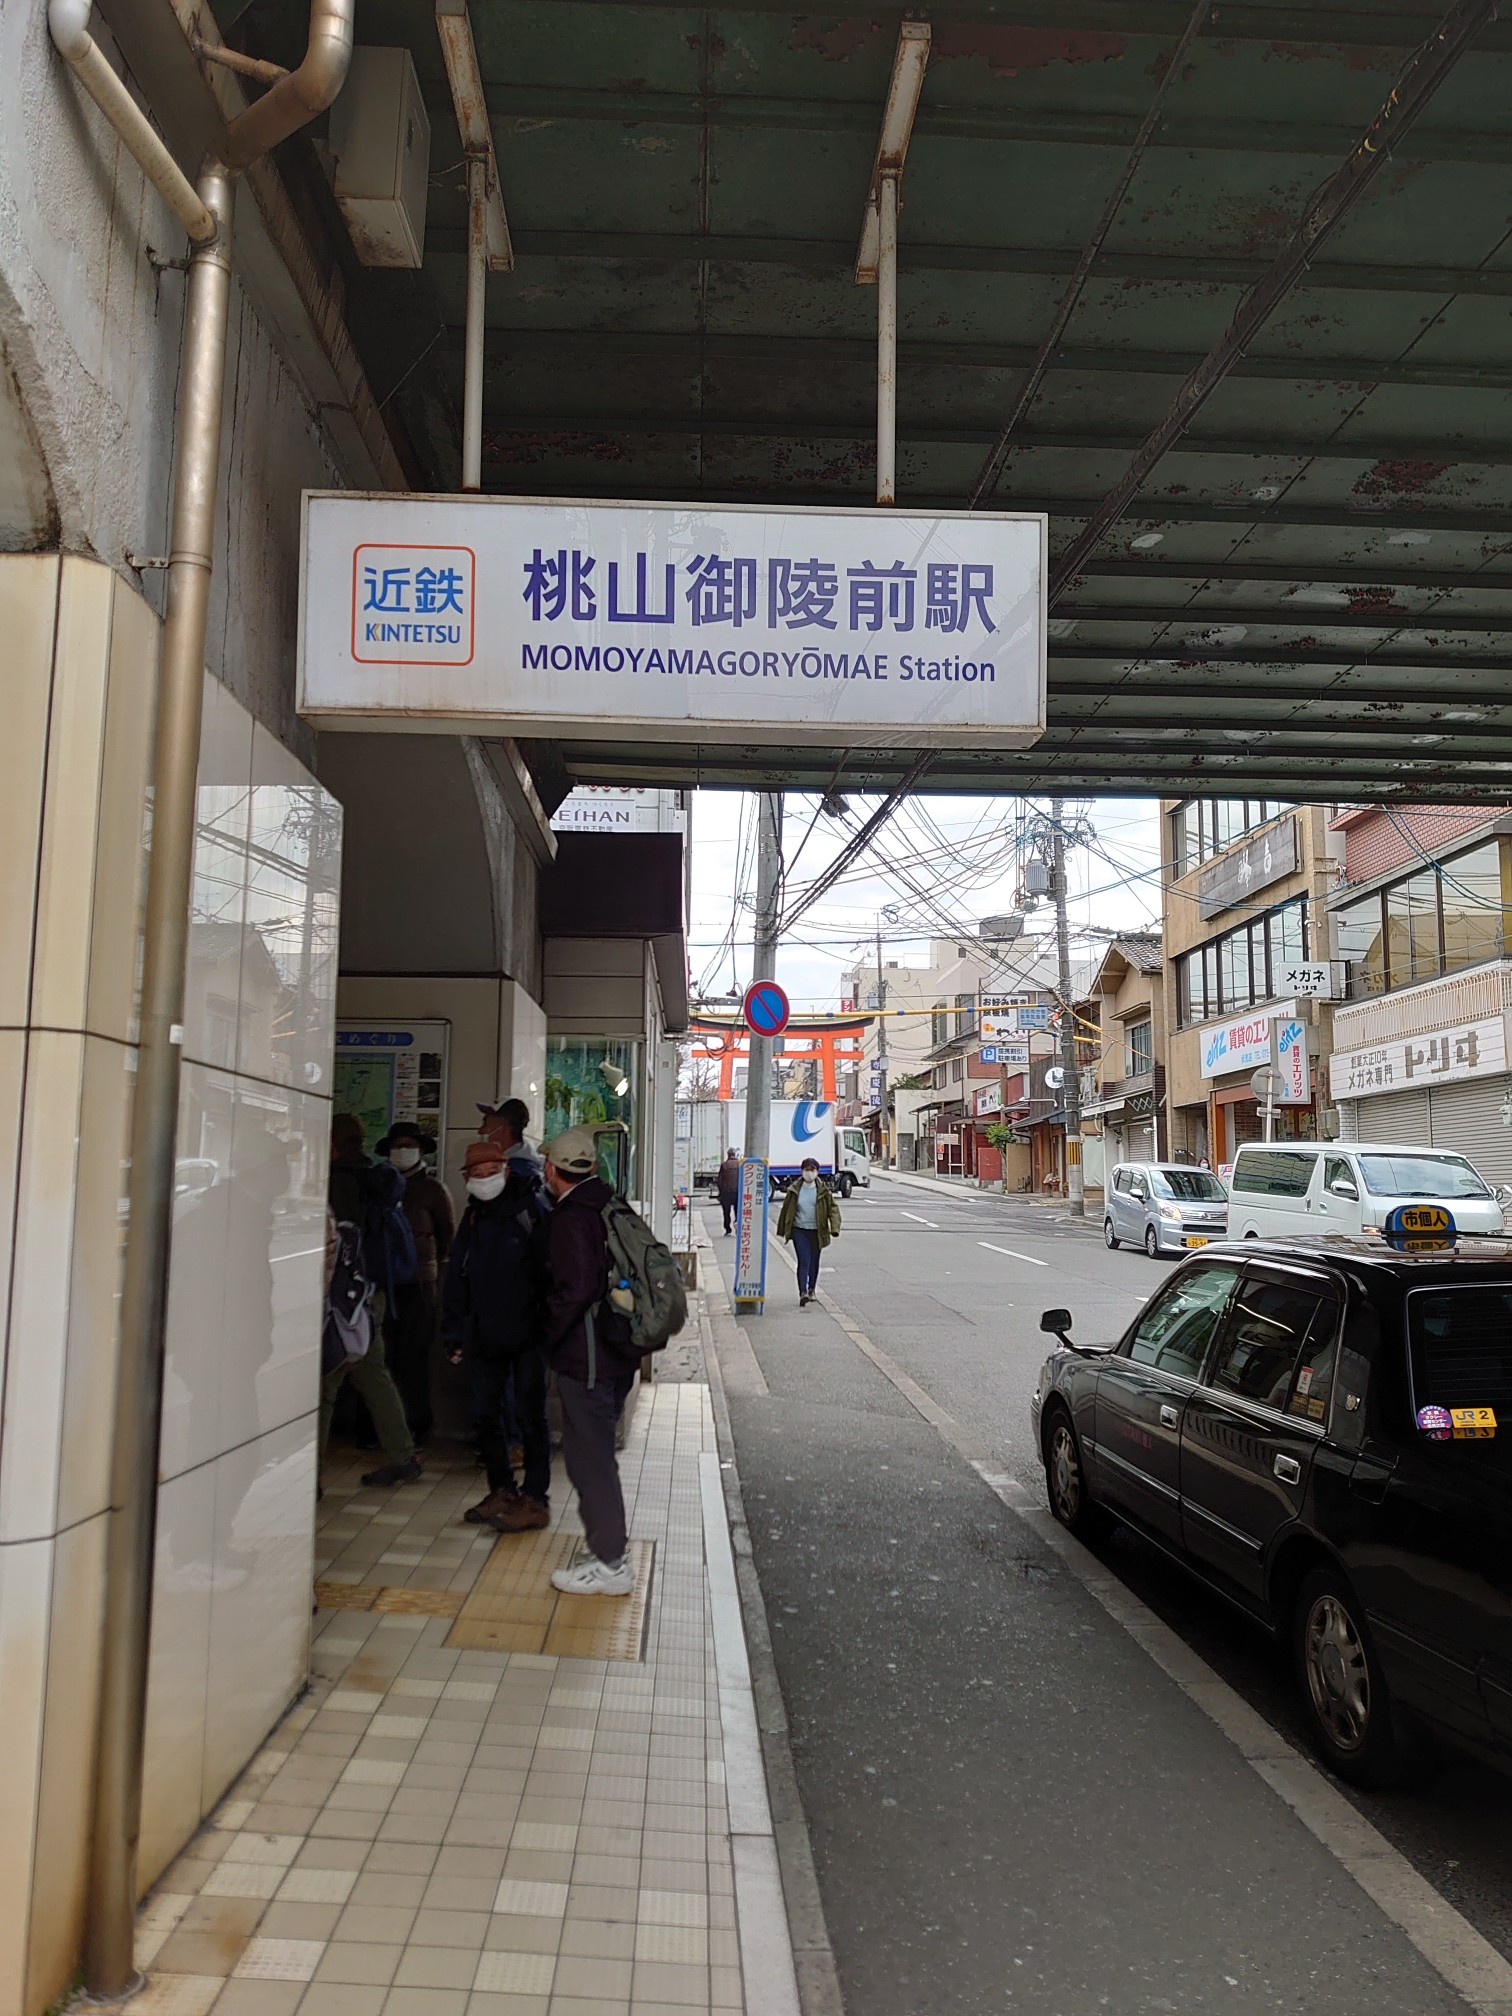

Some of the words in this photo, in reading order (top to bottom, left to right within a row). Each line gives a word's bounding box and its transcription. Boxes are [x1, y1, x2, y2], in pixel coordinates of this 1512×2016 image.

[364, 565, 464, 615] 近鉄
[522, 548, 997, 636] 桃山御陵前駅
[365, 622, 461, 645] KINTETSU
[522, 643, 888, 682] MOMOYAMAGORYŌMAE
[899, 654, 996, 684] Station
[550, 809, 630, 823] EIHAN
[1286, 969, 1326, 983] メガネ
[1293, 1045, 1304, 1098] 賃貸のエリッツ
[1351, 1050, 1389, 1070] 創業大正10年
[1349, 1064, 1394, 1091] メガネ専門
[755, 1163, 766, 1206] この場所は
[1404, 1211, 1447, 1228] 市個人
[1456, 1411, 1476, 1420] JR
[1479, 1410, 1490, 1420] 2
